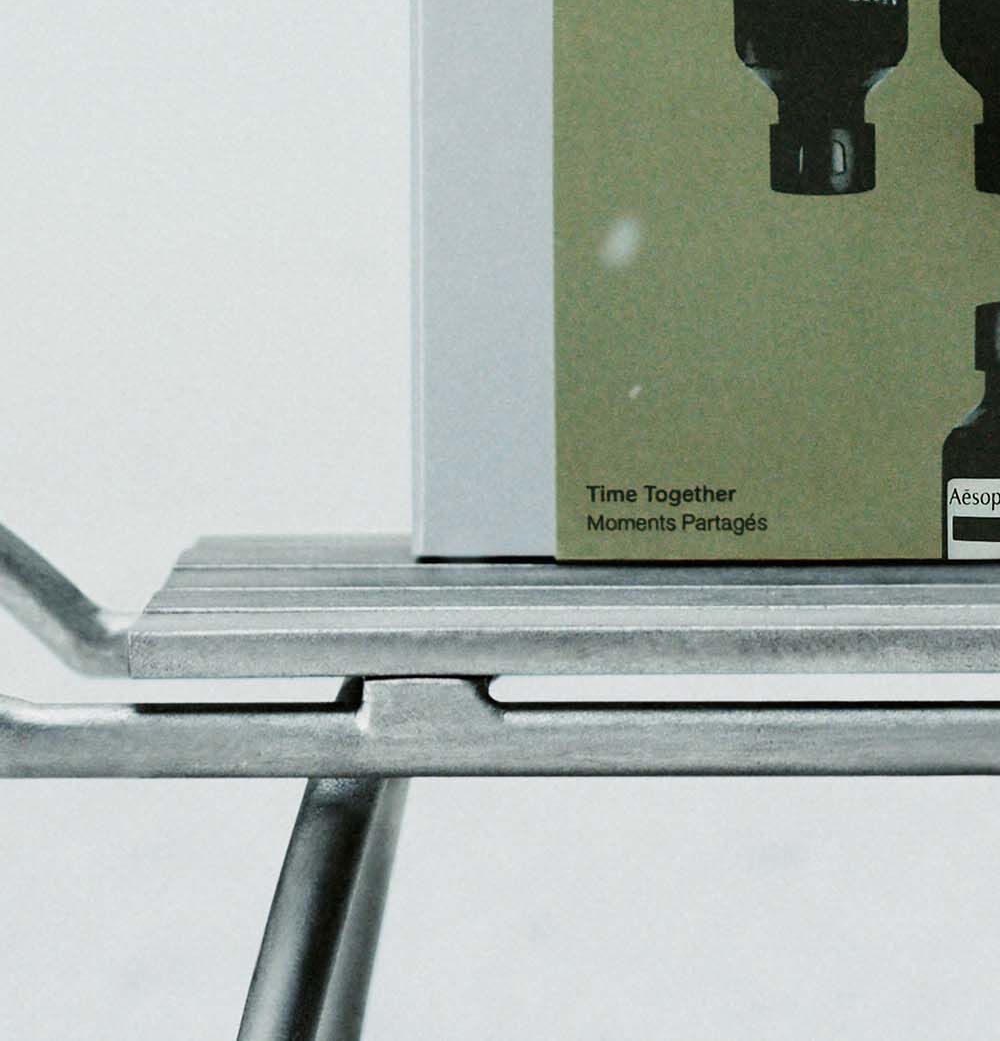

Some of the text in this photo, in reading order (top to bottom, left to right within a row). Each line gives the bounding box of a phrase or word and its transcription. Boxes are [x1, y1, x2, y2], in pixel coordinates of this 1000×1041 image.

[586, 484, 737, 507] Time Together
[586, 512, 769, 537] Moments Partagés
